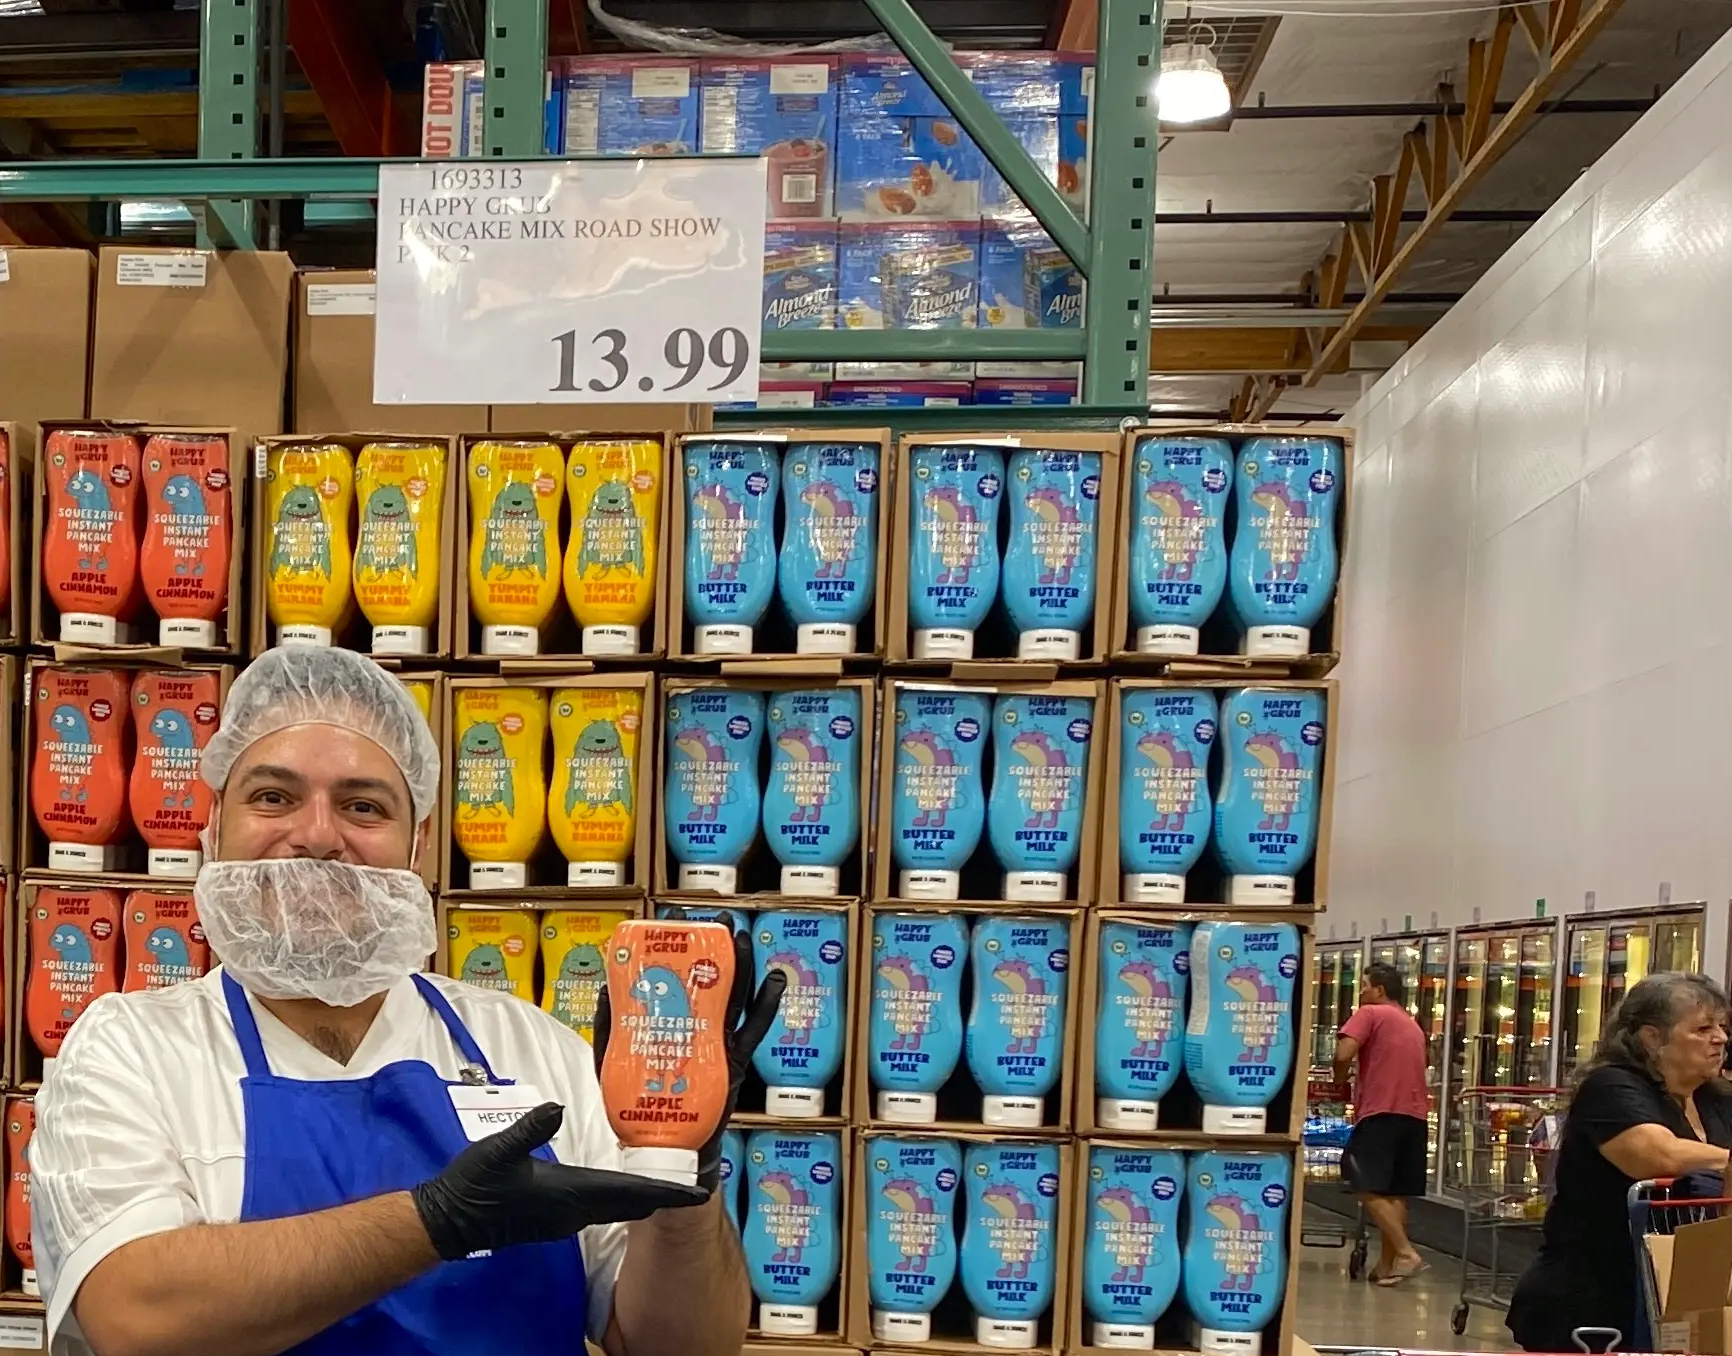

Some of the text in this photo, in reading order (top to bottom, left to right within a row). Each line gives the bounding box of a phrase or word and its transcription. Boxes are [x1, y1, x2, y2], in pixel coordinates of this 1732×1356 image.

[430, 168, 522, 190] 1693313
[399, 197, 477, 216] HAPPY
[520, 220, 565, 239] MIX
[574, 218, 641, 238] ROAD
[650, 217, 721, 237] SHOW
[460, 245, 470, 262] 2
[764, 283, 833, 321] Almond
[904, 282, 973, 319] Almond
[777, 303, 820, 328] Breeze
[549, 327, 749, 392] 13.99
[488, 583, 539, 596] YUMMY
[488, 594, 538, 606] BANANA
[1263, 700, 1301, 711] HAPPY
[1273, 708, 1301, 718] GRUB
[1248, 832, 1298, 845] BUTTER
[1259, 842, 1286, 855] MILK
[645, 930, 689, 943] HAPPY
[654, 942, 688, 954] GRUB
[620, 1015, 708, 1032] SQUEEZABLE
[631, 1031, 693, 1045] INSTANT
[630, 1045, 693, 1058] PANCAKE
[646, 1058, 680, 1070] MIX
[635, 1097, 683, 1110] APPLE
[478, 1112, 529, 1123] HECTO
[619, 1109, 699, 1123] CINNAMON
[885, 1273, 936, 1287] BUTTER
[894, 1283, 925, 1296] MILK
